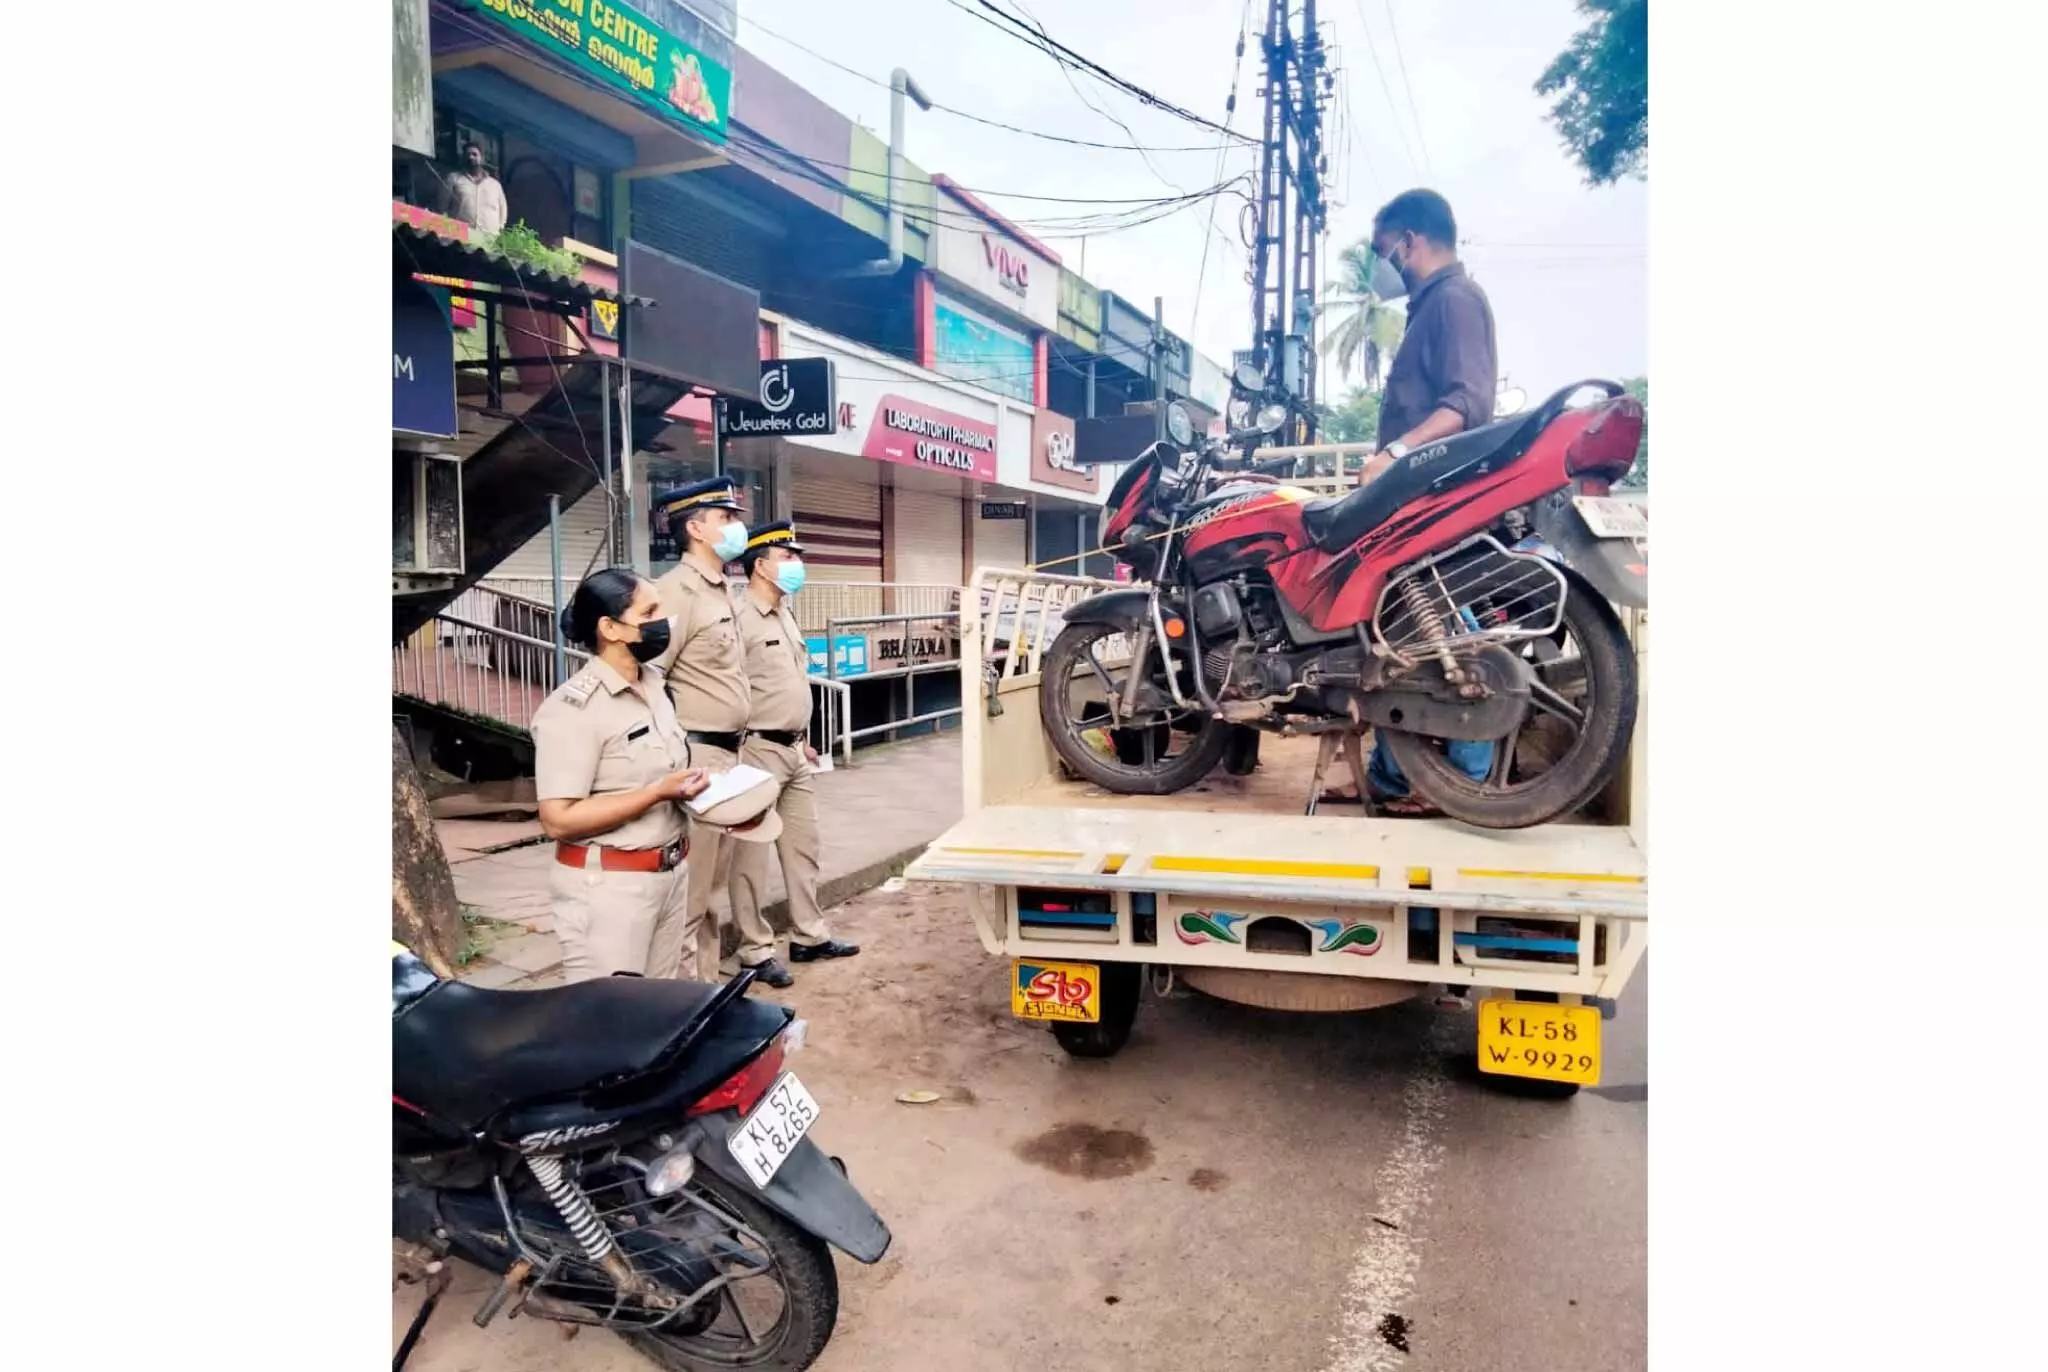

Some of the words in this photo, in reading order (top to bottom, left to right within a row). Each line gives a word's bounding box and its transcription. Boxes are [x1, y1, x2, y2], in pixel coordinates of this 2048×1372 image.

[589, 0, 659, 62] CENTRE
[730, 410, 791, 432] Jewelex
[796, 412, 827, 430] Gold
[914, 440, 975, 471] OPTICALS
[747, 1116, 774, 1147] KL
[770, 1084, 793, 1116] 57
[754, 1151, 773, 1177] H
[771, 1099, 812, 1154] 8465
